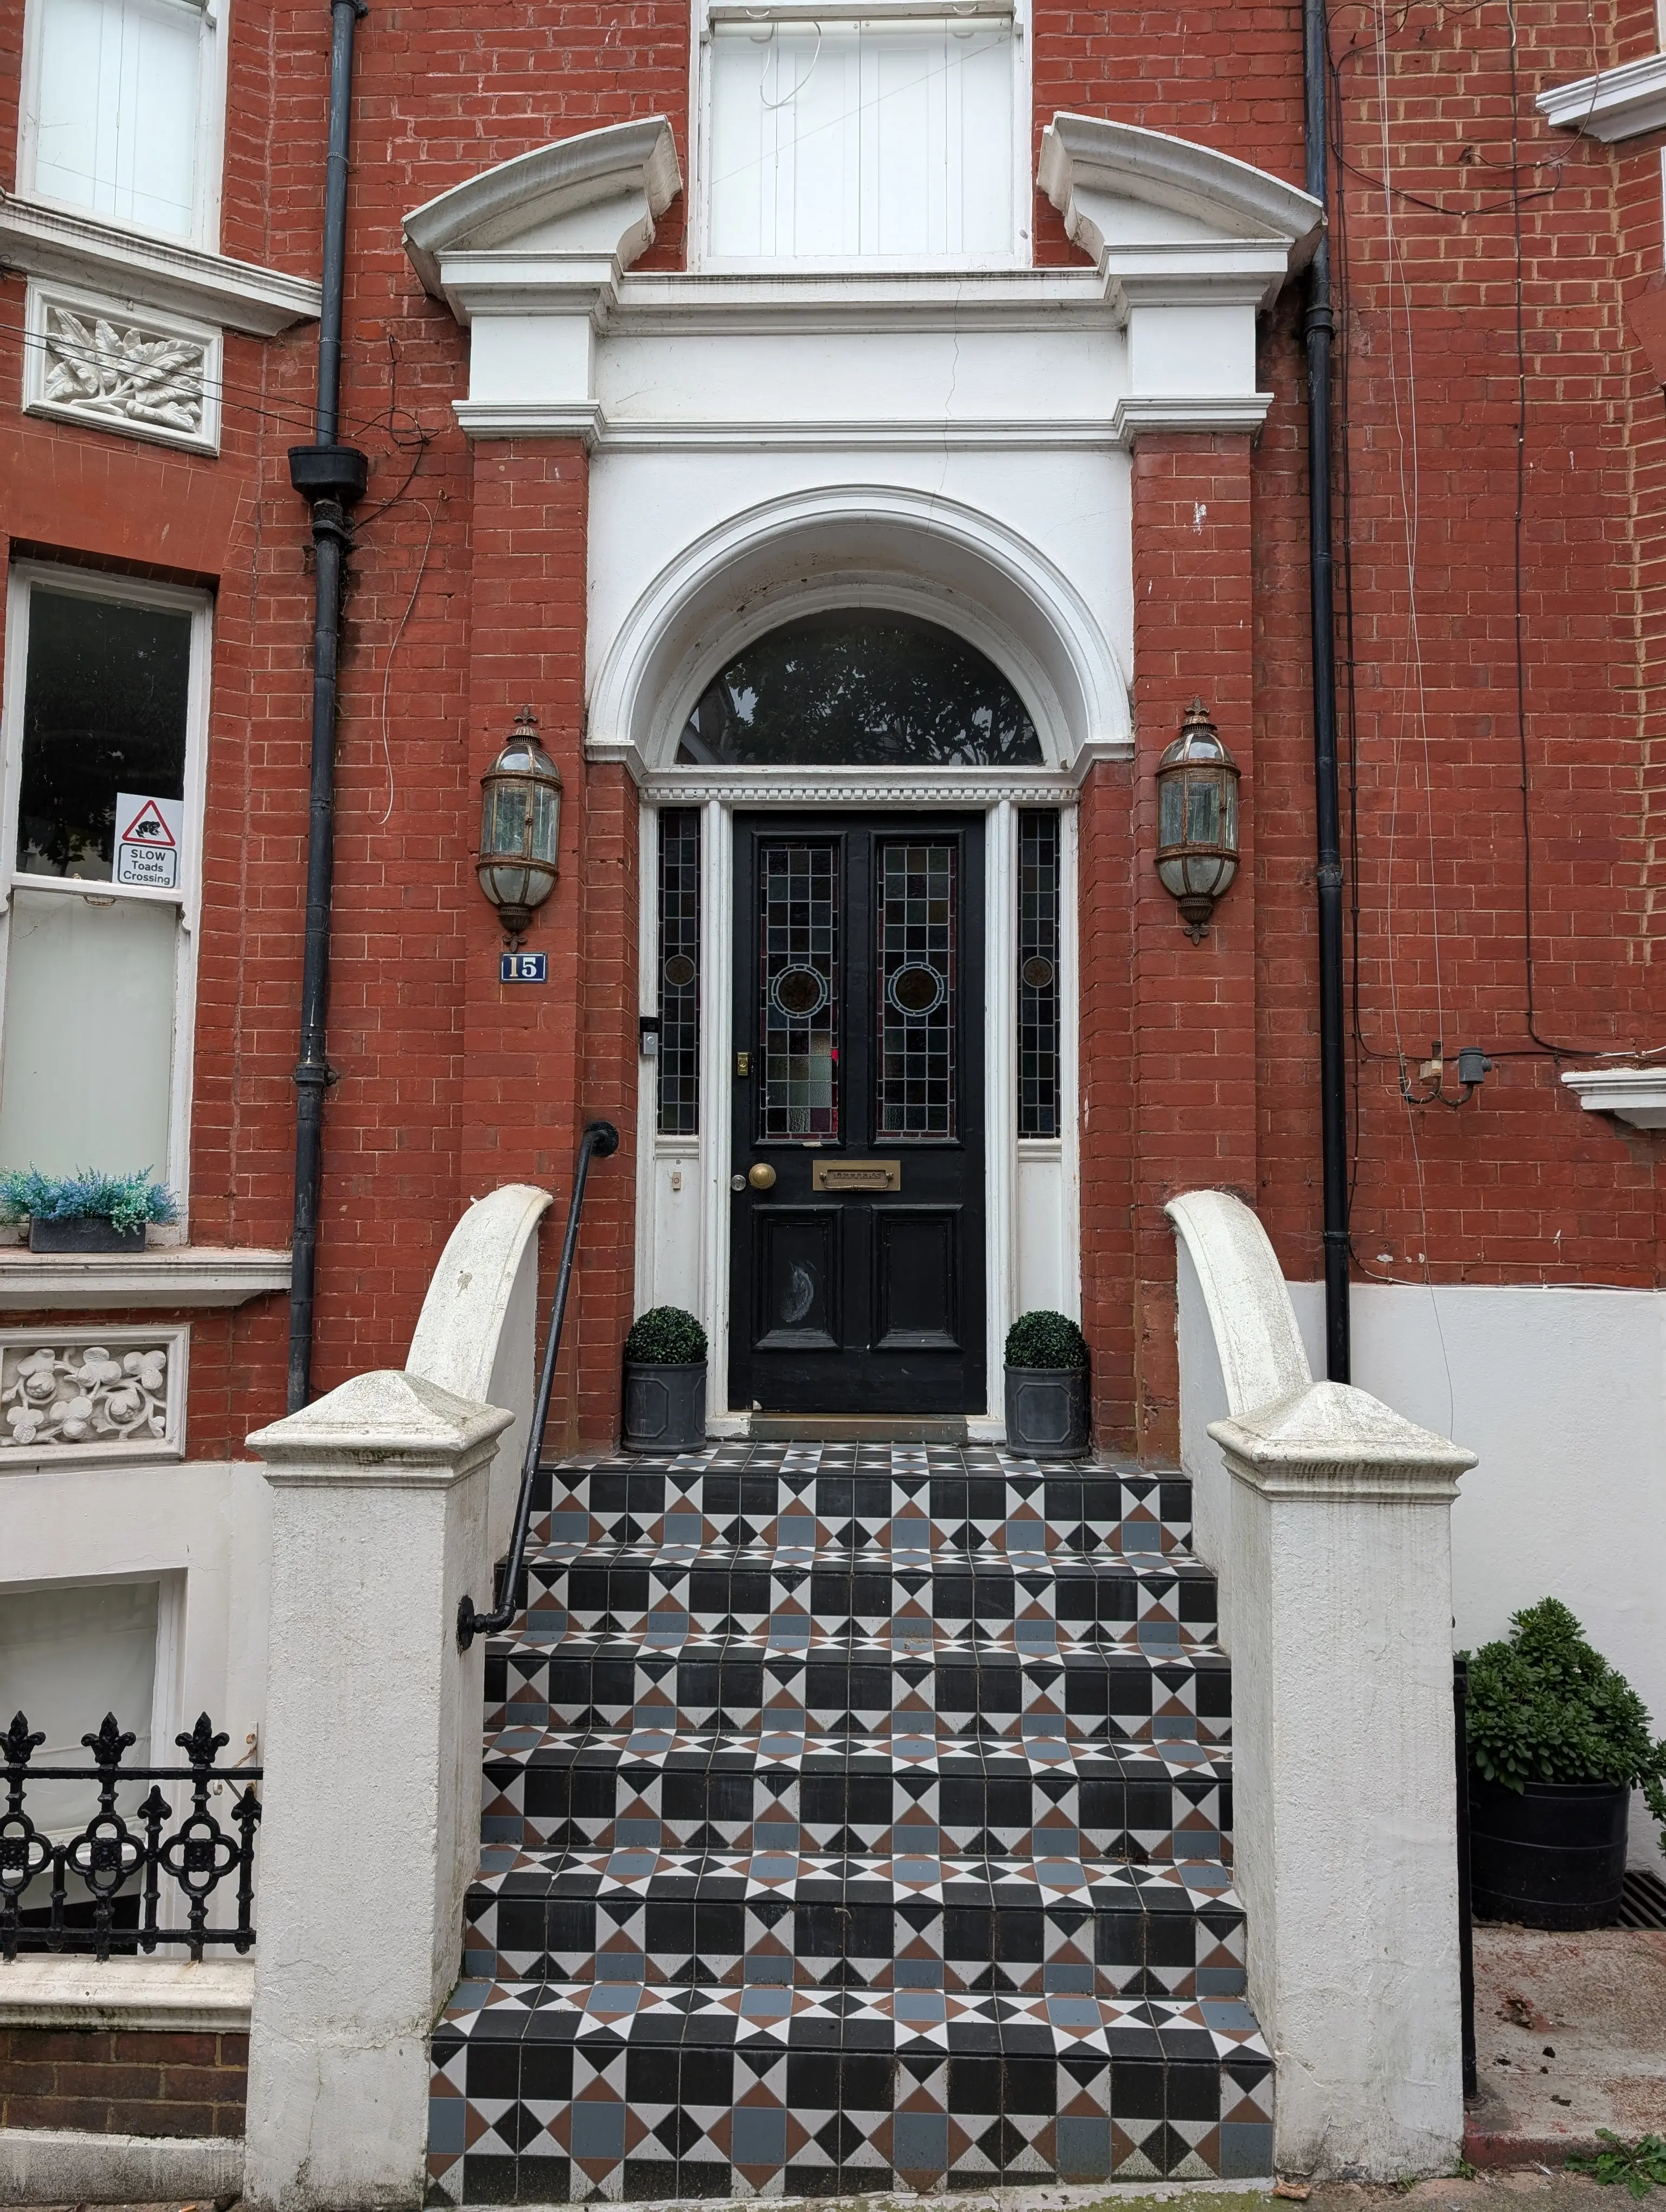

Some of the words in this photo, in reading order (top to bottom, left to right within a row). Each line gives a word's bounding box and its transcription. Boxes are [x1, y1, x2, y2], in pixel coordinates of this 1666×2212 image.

[130, 849, 166, 861] SLOW
[131, 860, 163, 872] Toads
[124, 870, 170, 885] Crossing
[509, 957, 536, 977] 15
